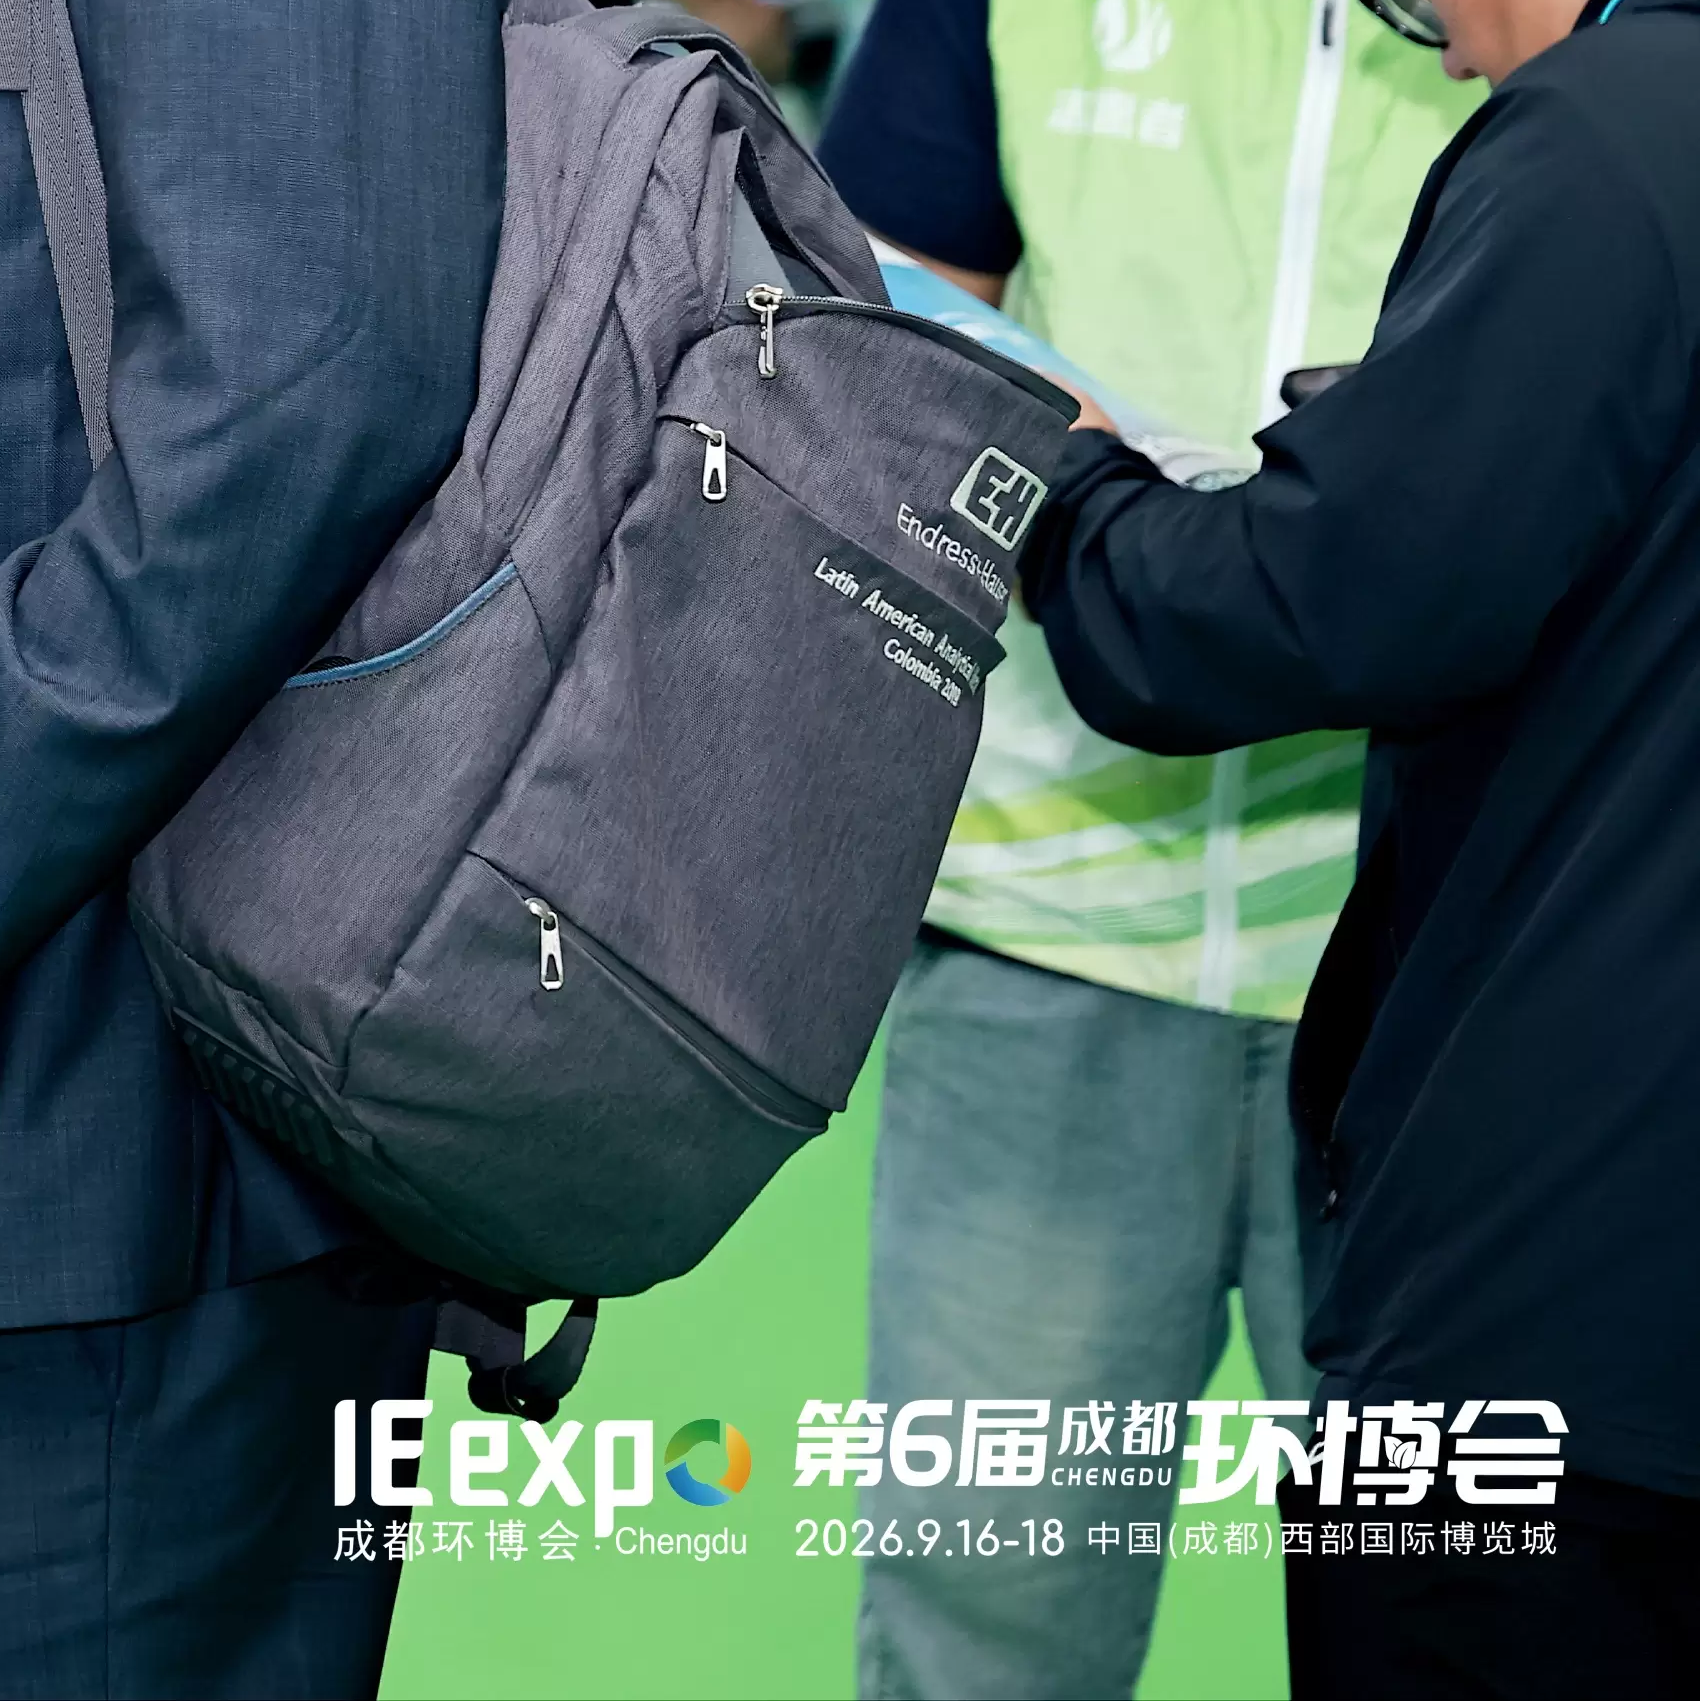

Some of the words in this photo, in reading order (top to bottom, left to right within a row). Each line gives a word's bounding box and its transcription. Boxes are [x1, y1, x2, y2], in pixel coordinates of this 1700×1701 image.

[813, 556, 860, 600] Latin
[862, 588, 935, 647] American
[884, 637, 942, 691] Colombia
